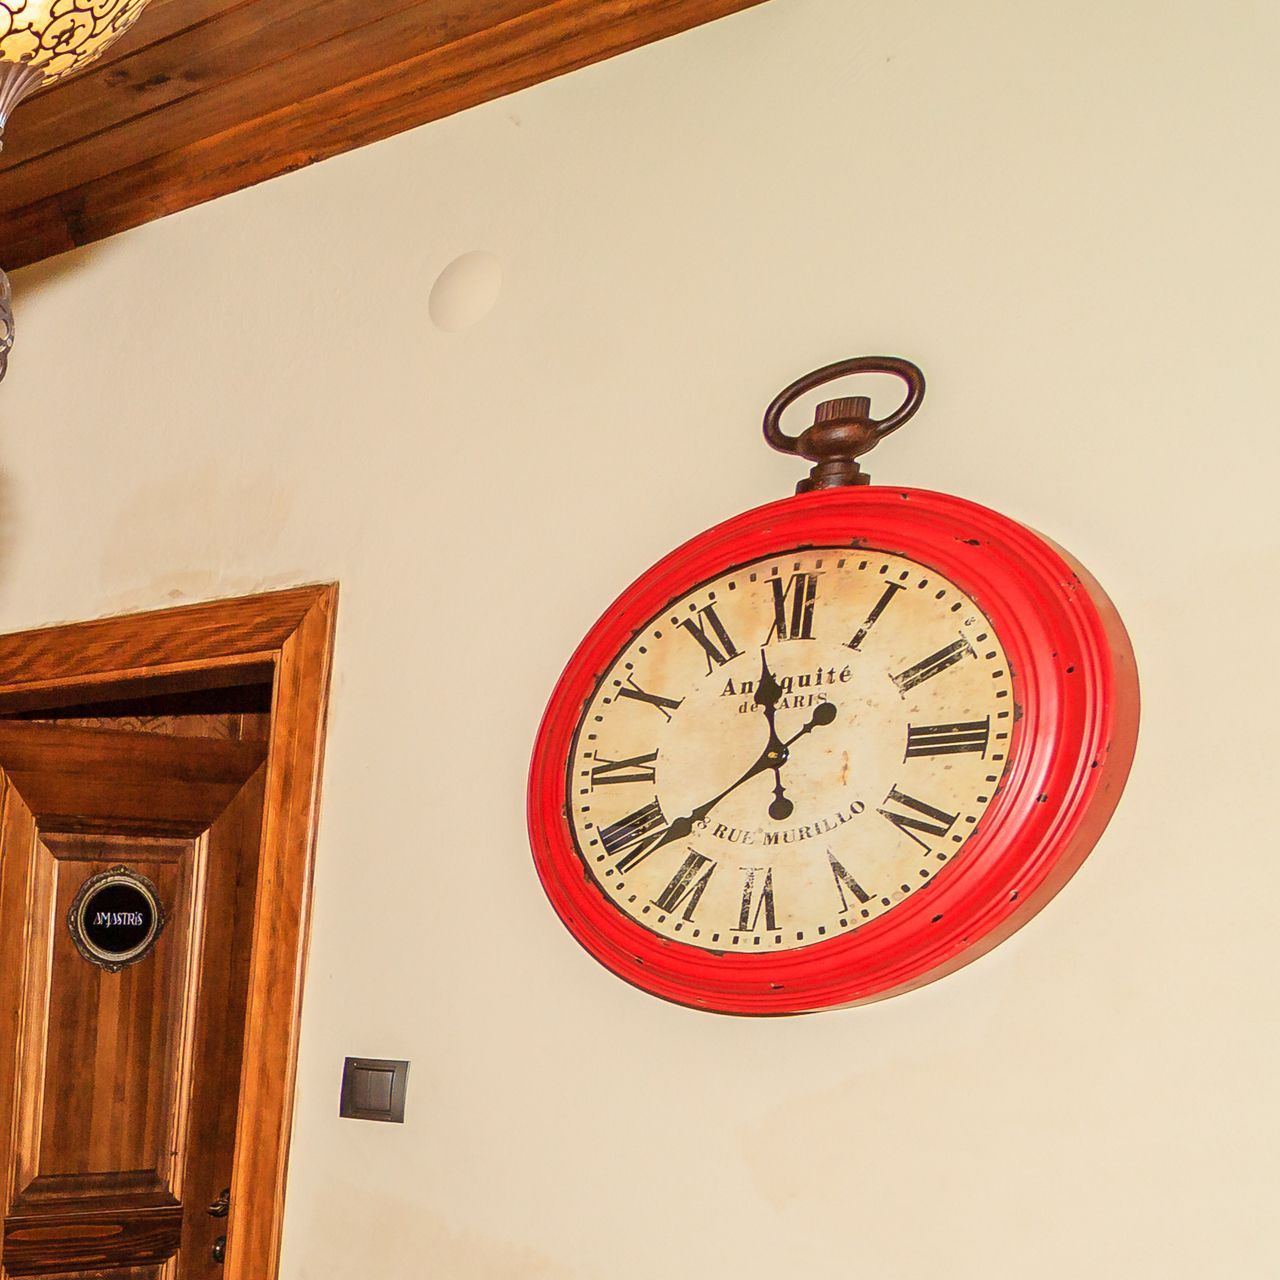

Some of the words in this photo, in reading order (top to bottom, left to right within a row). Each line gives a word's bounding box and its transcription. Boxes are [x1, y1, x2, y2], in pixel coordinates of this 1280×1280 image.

[675, 600, 746, 677] XI
[761, 571, 827, 647] XII
[613, 672, 686, 723] X
[720, 665, 852, 697] Anquité
[888, 630, 978, 700] II
[738, 701, 759, 714] de
[773, 692, 827, 710] ARIS
[590, 747, 659, 793] IX
[902, 714, 990, 764] III
[712, 822, 755, 846] RUE
[762, 800, 865, 846] MURILLO
[875, 783, 961, 857] IV
[649, 846, 718, 923] VII
[729, 867, 783, 932] VI
[826, 849, 878, 914] V
